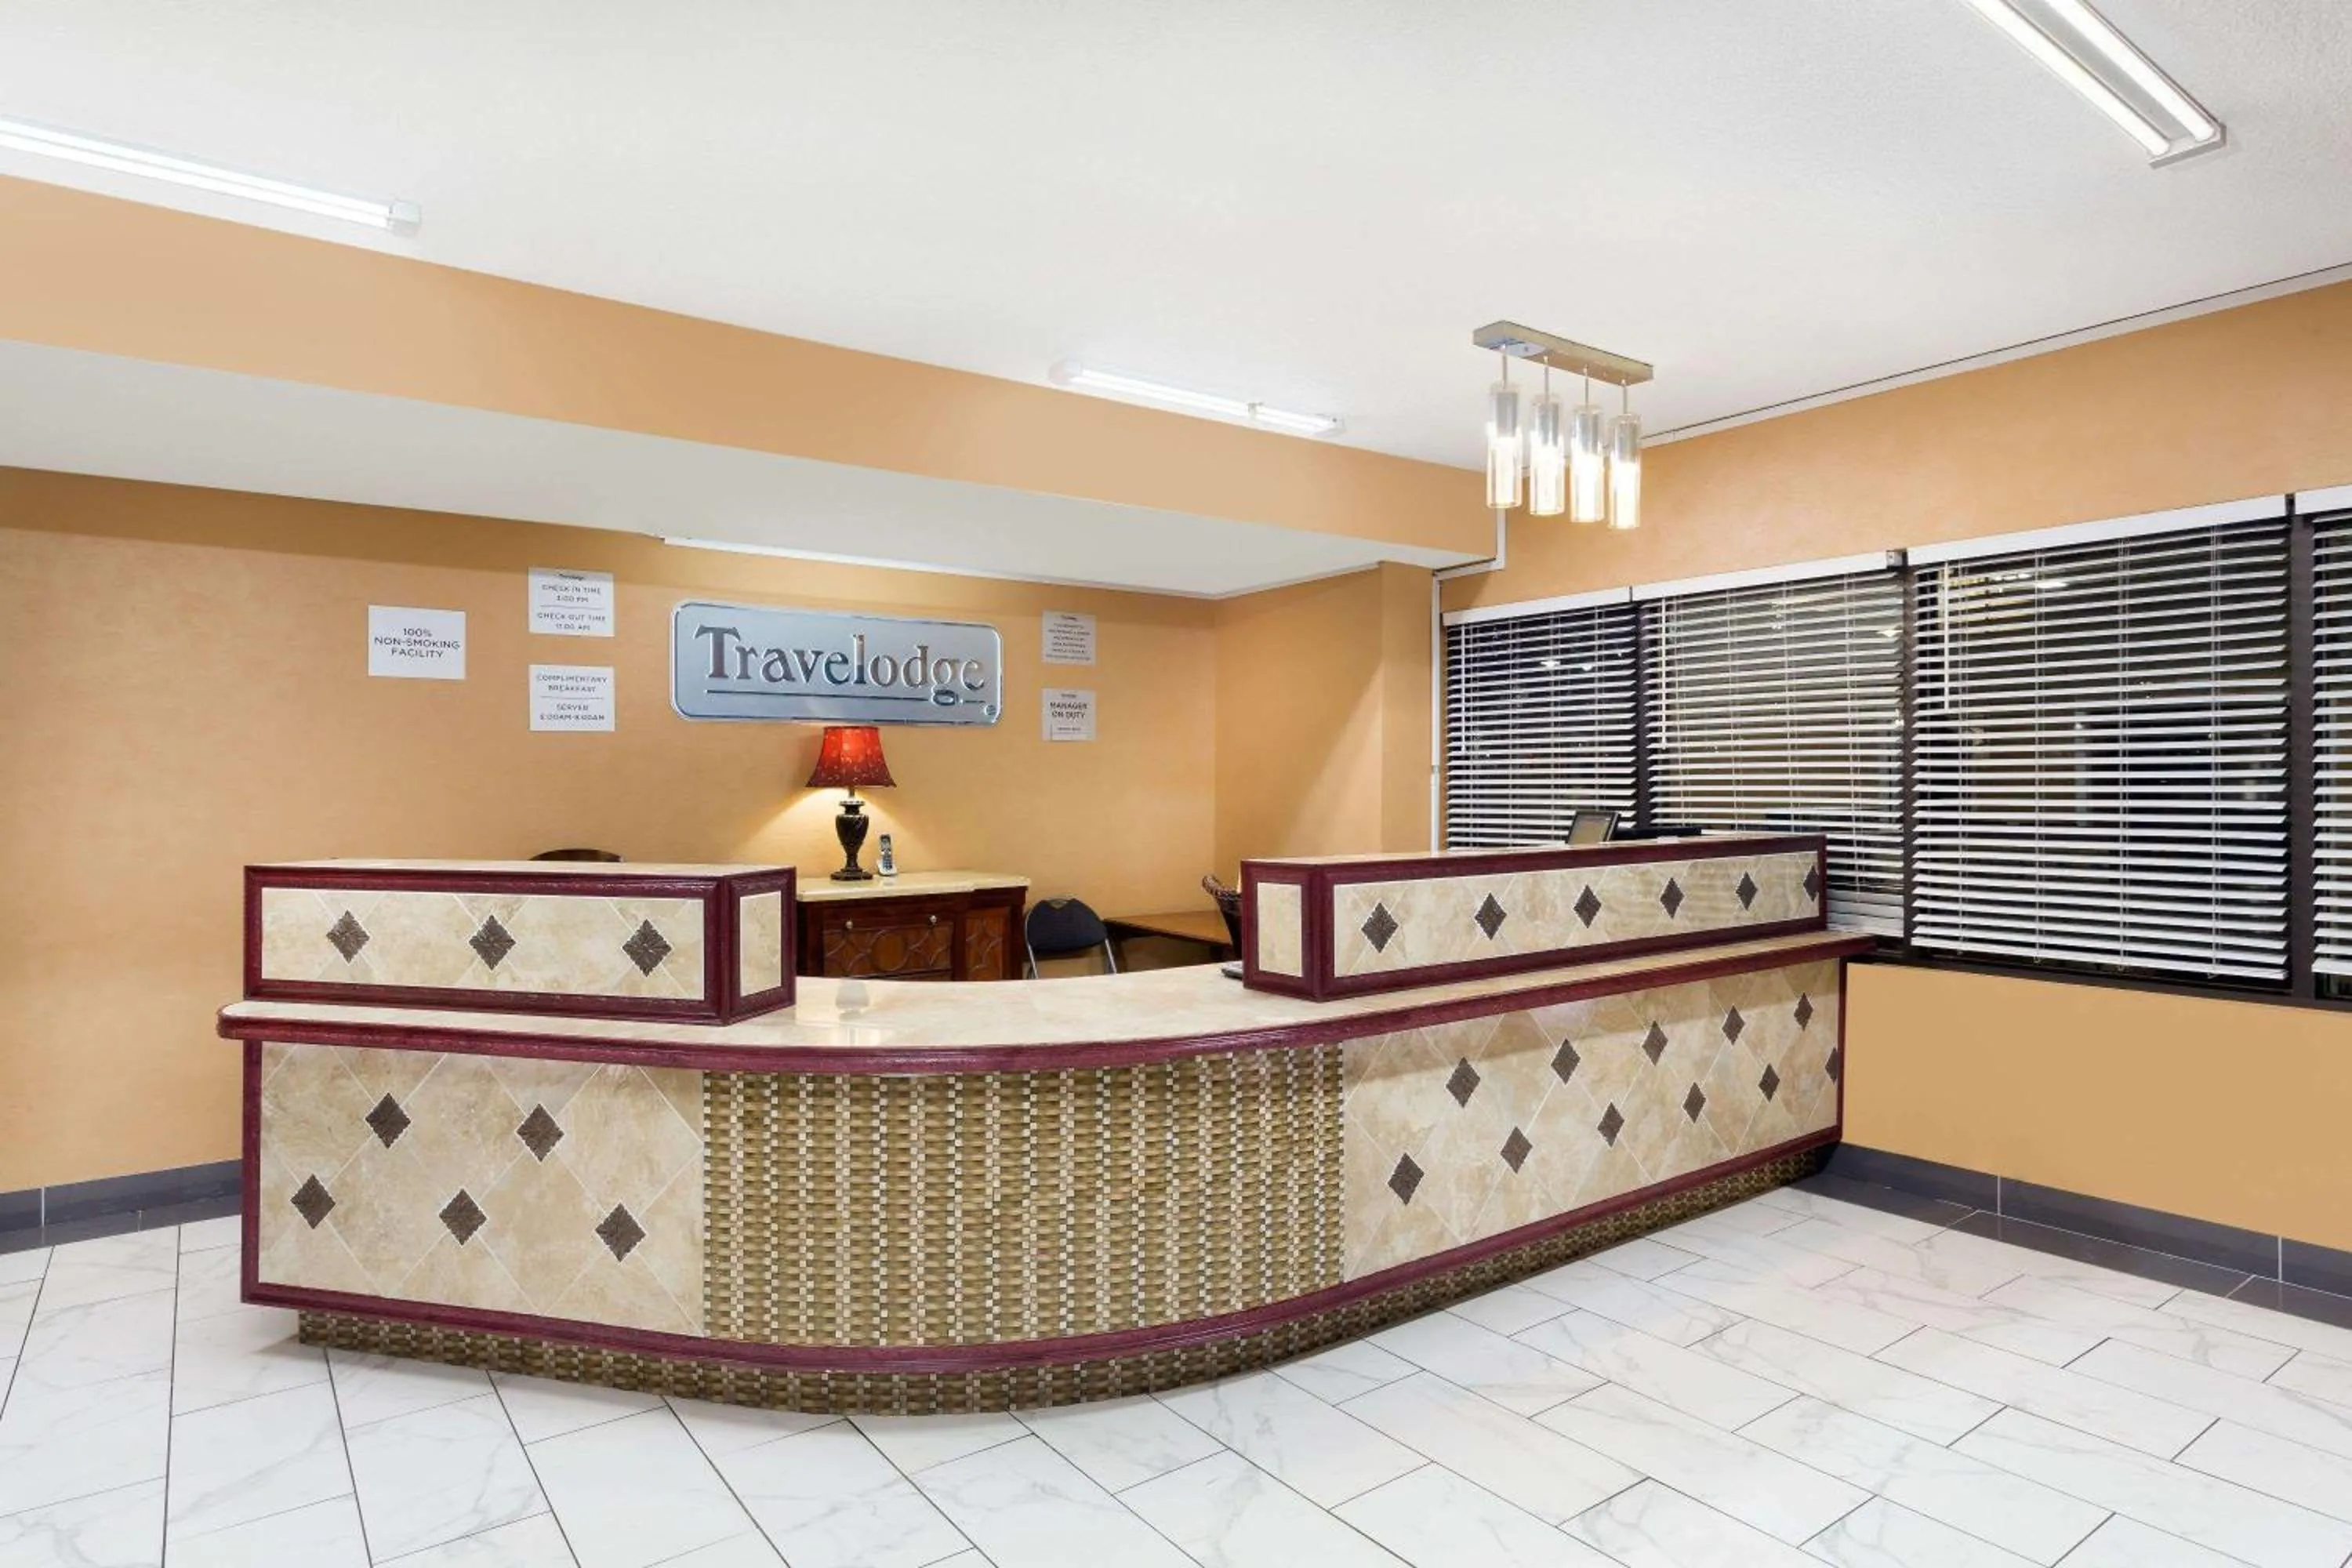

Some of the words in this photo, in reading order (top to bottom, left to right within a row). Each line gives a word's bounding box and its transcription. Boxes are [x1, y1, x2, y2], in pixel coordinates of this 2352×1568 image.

[583, 586, 601, 595] TIME
[403, 627, 433, 637] 100%
[374, 637, 461, 649] NON-SMOKING
[391, 648, 444, 659] FACILITY
[693, 624, 985, 706] Travelodge
[1050, 702, 1087, 710] MANAGER
